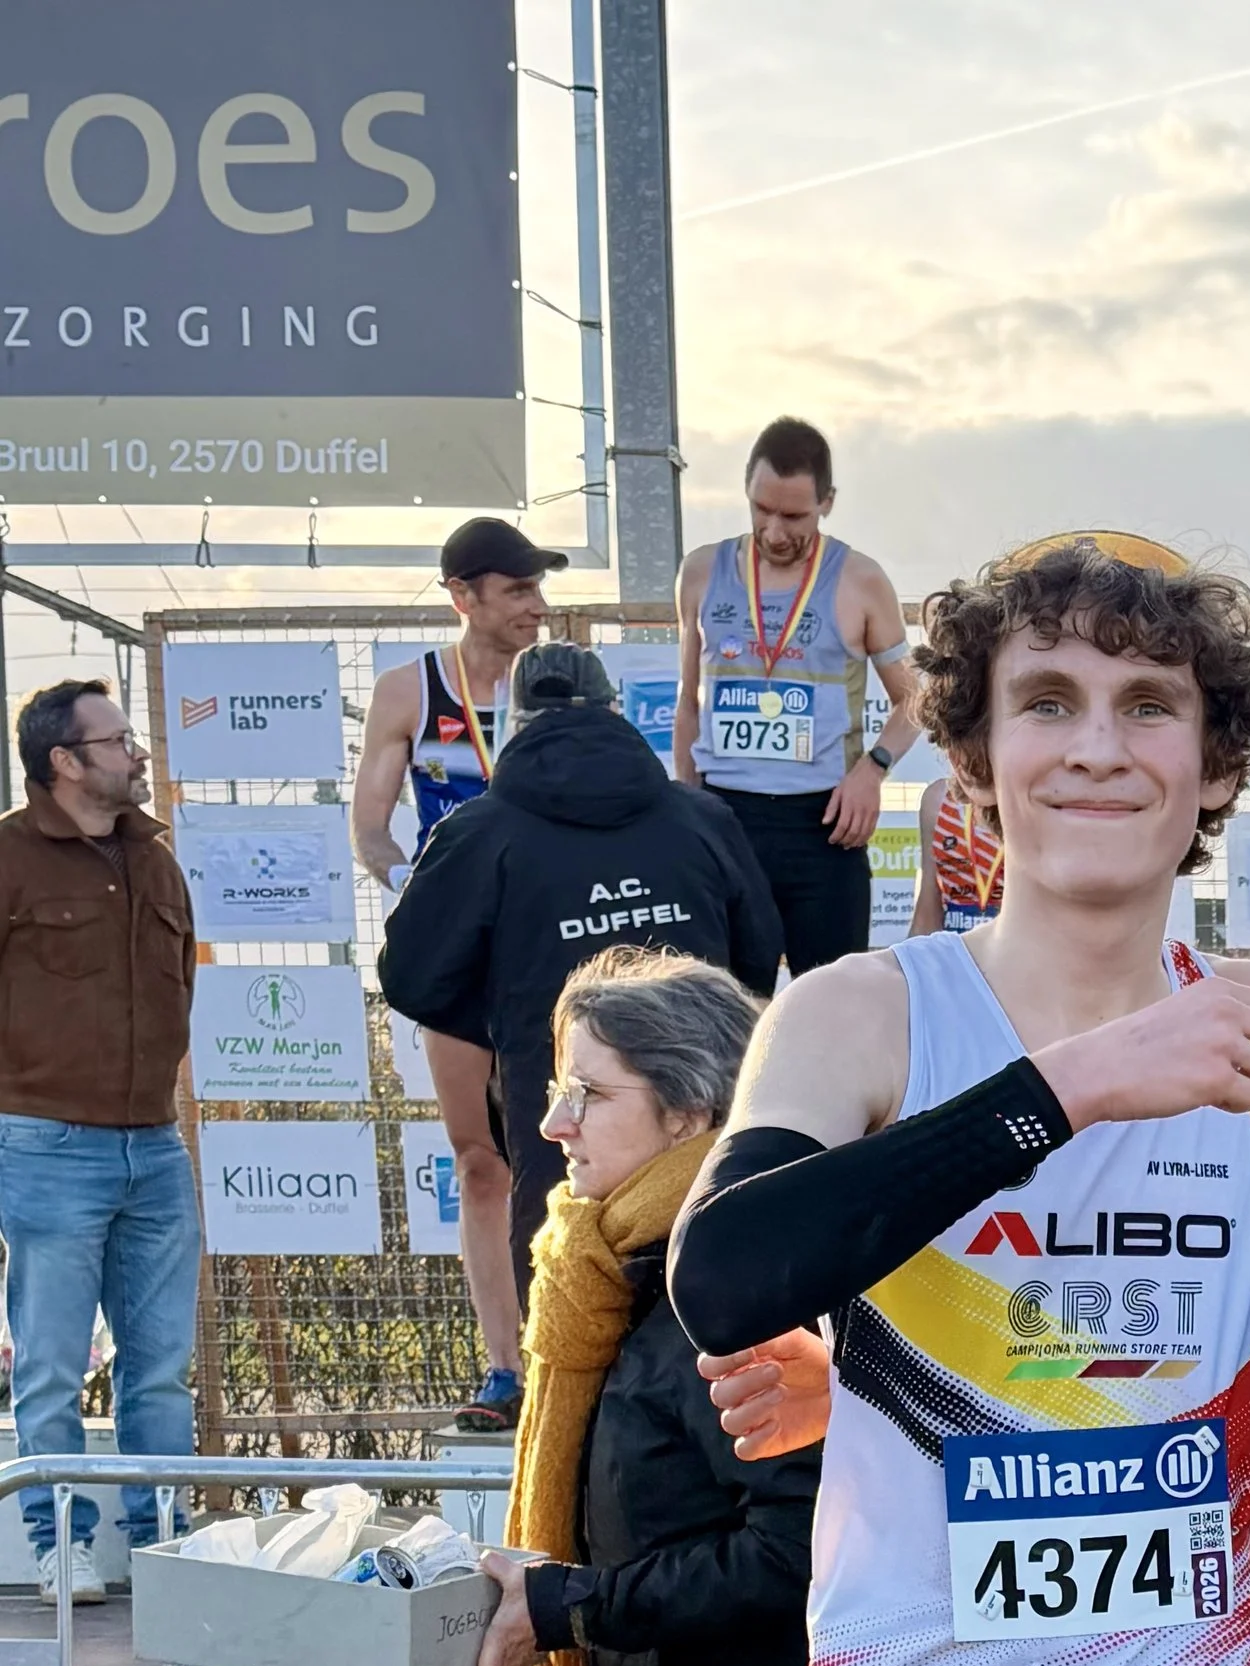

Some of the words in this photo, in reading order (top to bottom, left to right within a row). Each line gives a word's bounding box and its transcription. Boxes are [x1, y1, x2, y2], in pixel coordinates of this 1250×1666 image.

[4, 305, 378, 347] ZORGING
[0, 437, 88, 473] Bruul
[102, 439, 157, 479] 10,
[169, 439, 263, 474] 2570
[277, 437, 388, 475] Duffel
[229, 689, 327, 710] runners'
[719, 688, 761, 706] Allia
[865, 700, 889, 713] ru
[230, 711, 268, 730] lab
[638, 701, 676, 725] Le
[865, 714, 883, 734] la
[719, 720, 789, 752] 7973
[223, 887, 310, 899] R-WORKS
[589, 878, 652, 904] A.C.
[559, 903, 692, 940] DUFFEL
[215, 1037, 264, 1055] VZW
[272, 1037, 343, 1061] Marjan
[1147, 1160, 1160, 1176] AV
[1163, 1161, 1230, 1179] LYRA-LIERSE
[223, 1166, 357, 1198] Kiliaan
[235, 1202, 295, 1214] Brasserie
[308, 1202, 350, 1214] Duffel
[1007, 1278, 1204, 1338] CRST
[1075, 1343, 1127, 1355] RUNNING
[1130, 1343, 1168, 1356] STORE
[1172, 1344, 1202, 1356] TEAM
[964, 1453, 1145, 1501] Allianz
[974, 1528, 1175, 1619] 4374
[1200, 1556, 1223, 1615] 2026
